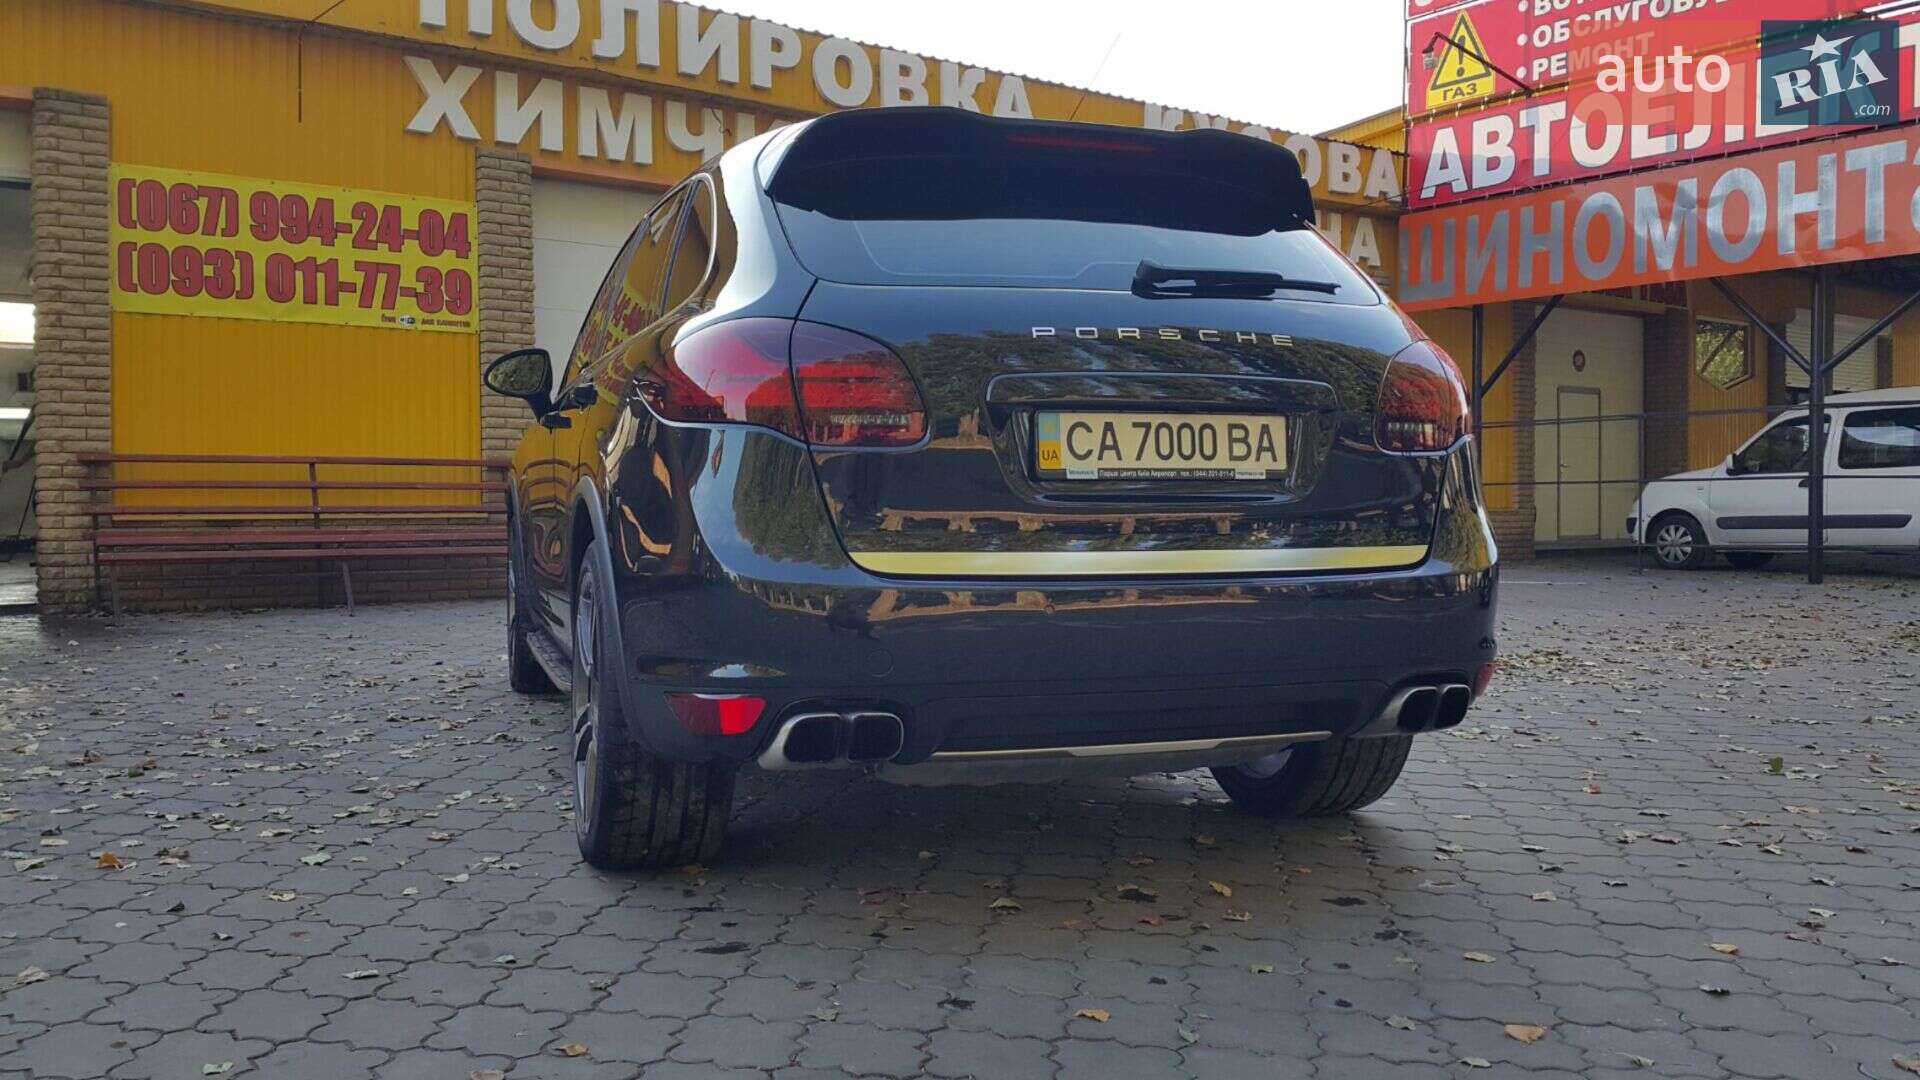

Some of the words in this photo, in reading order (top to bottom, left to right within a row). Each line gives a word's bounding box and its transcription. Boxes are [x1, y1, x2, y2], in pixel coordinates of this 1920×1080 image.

[1532, 0, 1728, 48] ОБСЛУГОВ
[1531, 31, 1656, 82] РЕМОНТ
[1442, 83, 1478, 102] ГАЗ
[117, 177, 240, 238] (067)
[249, 190, 472, 260] 994-24-04
[1401, 139, 1920, 304] ШИНОМОНТ
[117, 241, 254, 300] (093)
[264, 252, 473, 316] 011-77-39
[1031, 326, 1294, 347] PORSCHE
[1041, 450, 1059, 461] UA
[1066, 421, 1122, 462] CA
[1131, 421, 1218, 462] 7000
[1227, 422, 1278, 463] BA
